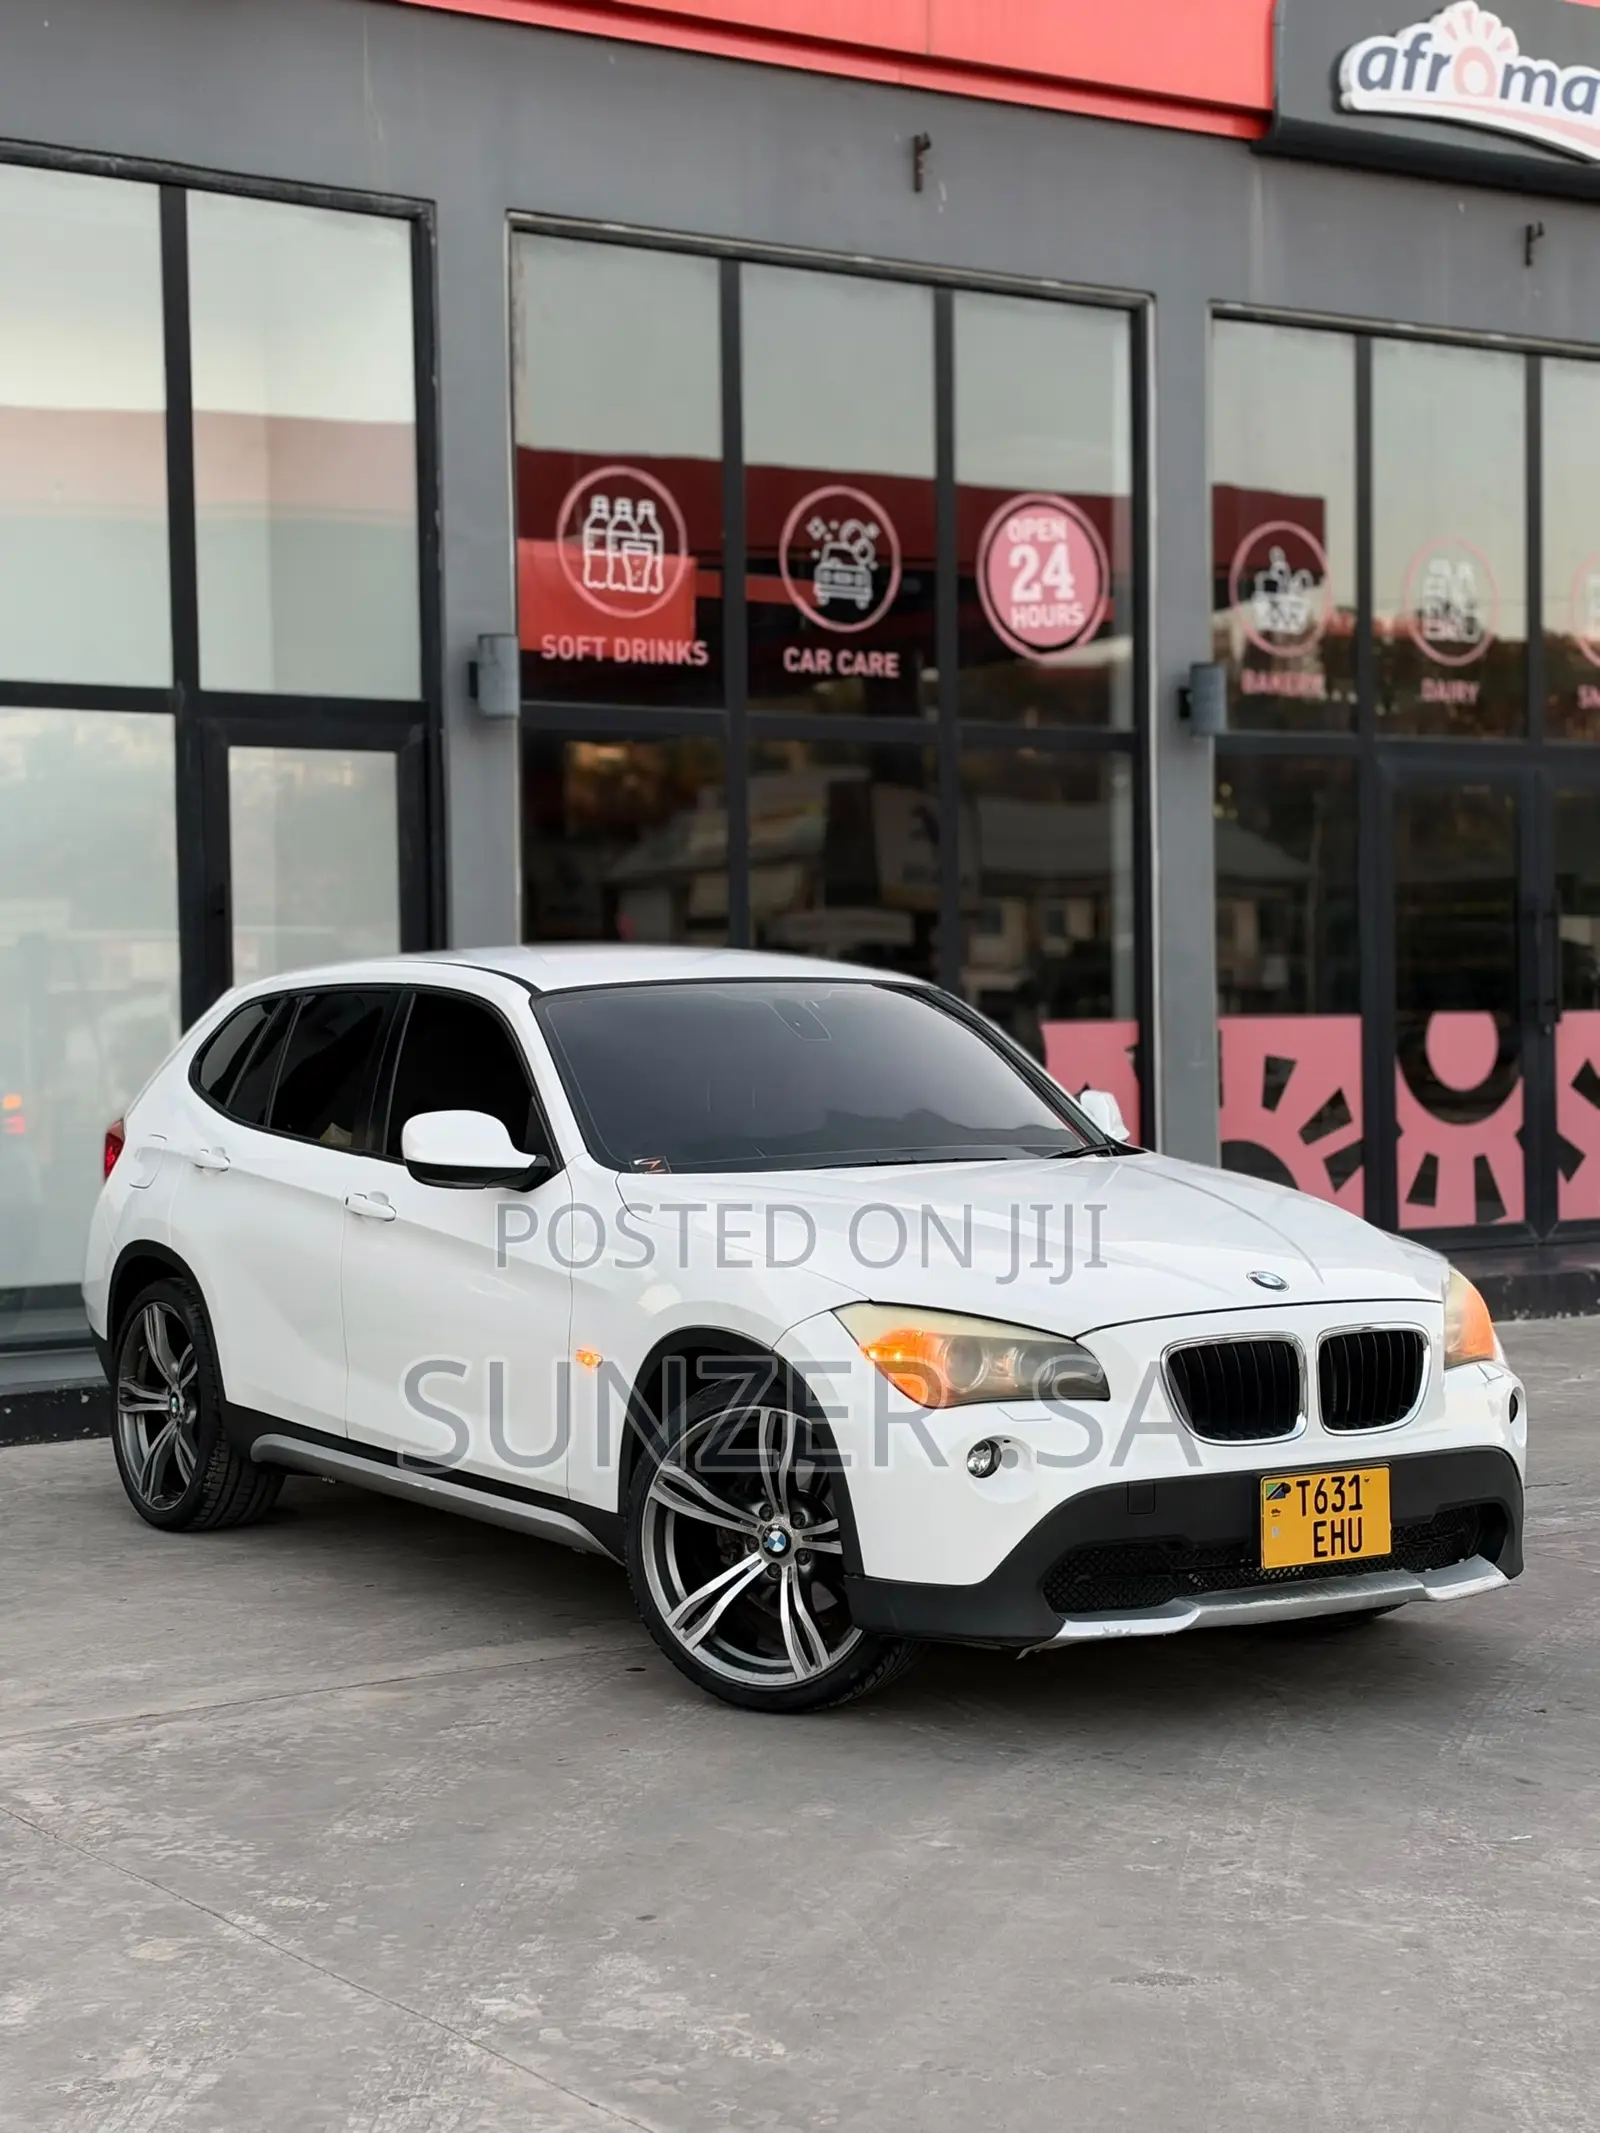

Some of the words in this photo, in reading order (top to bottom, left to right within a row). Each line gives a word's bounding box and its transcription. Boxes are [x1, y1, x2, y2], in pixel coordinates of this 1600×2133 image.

[1006, 517, 1068, 543] OPEN
[1008, 543, 1076, 603] 24
[1011, 602, 1084, 629] HOURS
[541, 634, 606, 661] SOFT
[614, 637, 709, 665] DRINKS
[783, 647, 832, 674] CAR
[836, 651, 899, 678] CARE
[1296, 1474, 1363, 1517] T631
[1313, 1516, 1363, 1558] EHU
